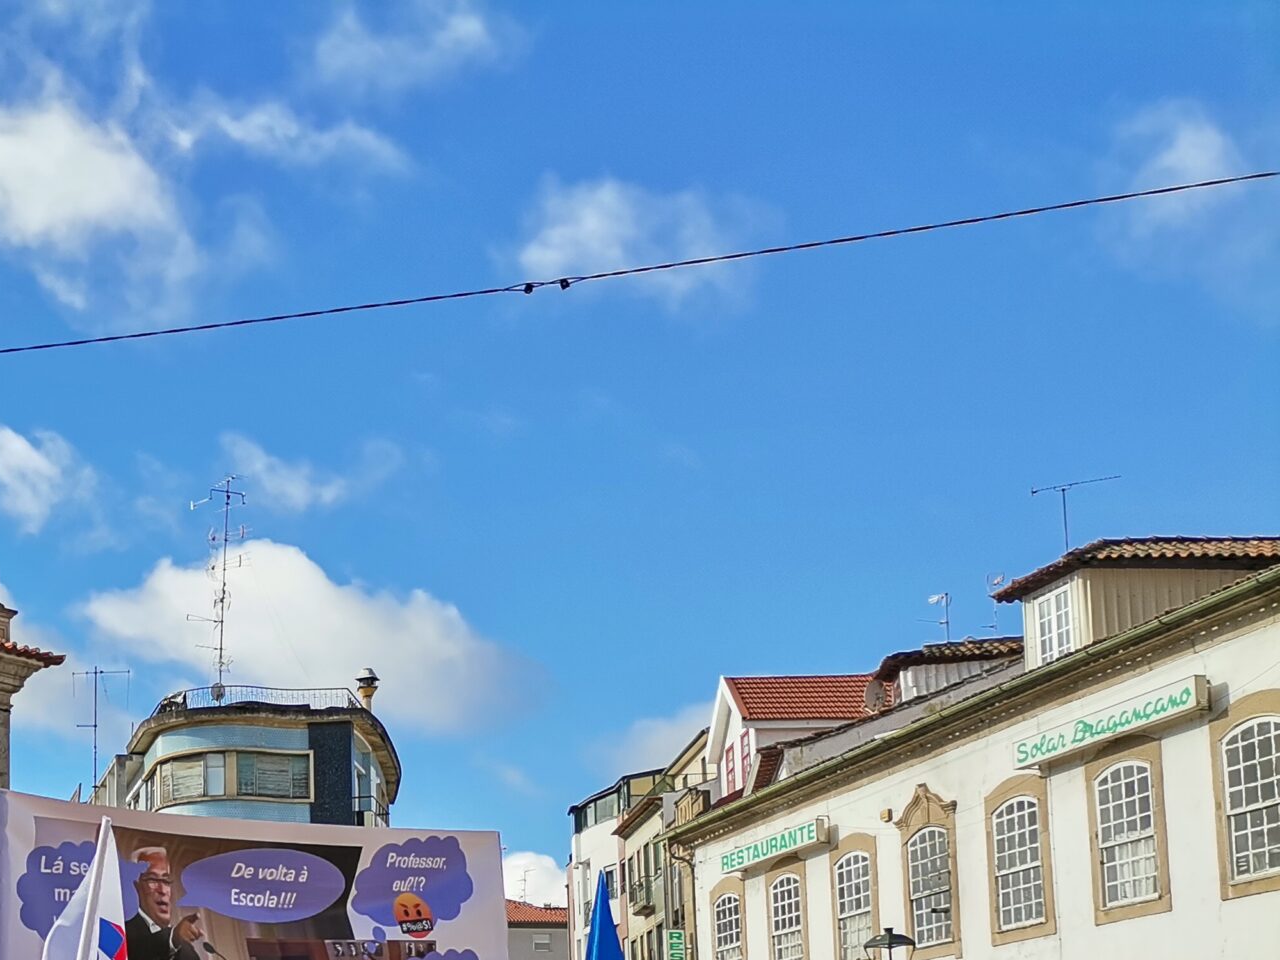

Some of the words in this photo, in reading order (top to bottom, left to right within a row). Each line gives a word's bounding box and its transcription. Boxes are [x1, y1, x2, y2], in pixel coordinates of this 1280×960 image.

[1016, 734, 1066, 763] Solar
[1071, 687, 1192, 743] Bragançano
[721, 822, 815, 871] RESTAURANTE
[40, 856, 62, 873] Lá
[386, 852, 447, 870] Professor,
[231, 862, 254, 878] De
[258, 864, 295, 882] volta
[298, 866, 308, 882] à
[231, 888, 297, 908] Escola!!!
